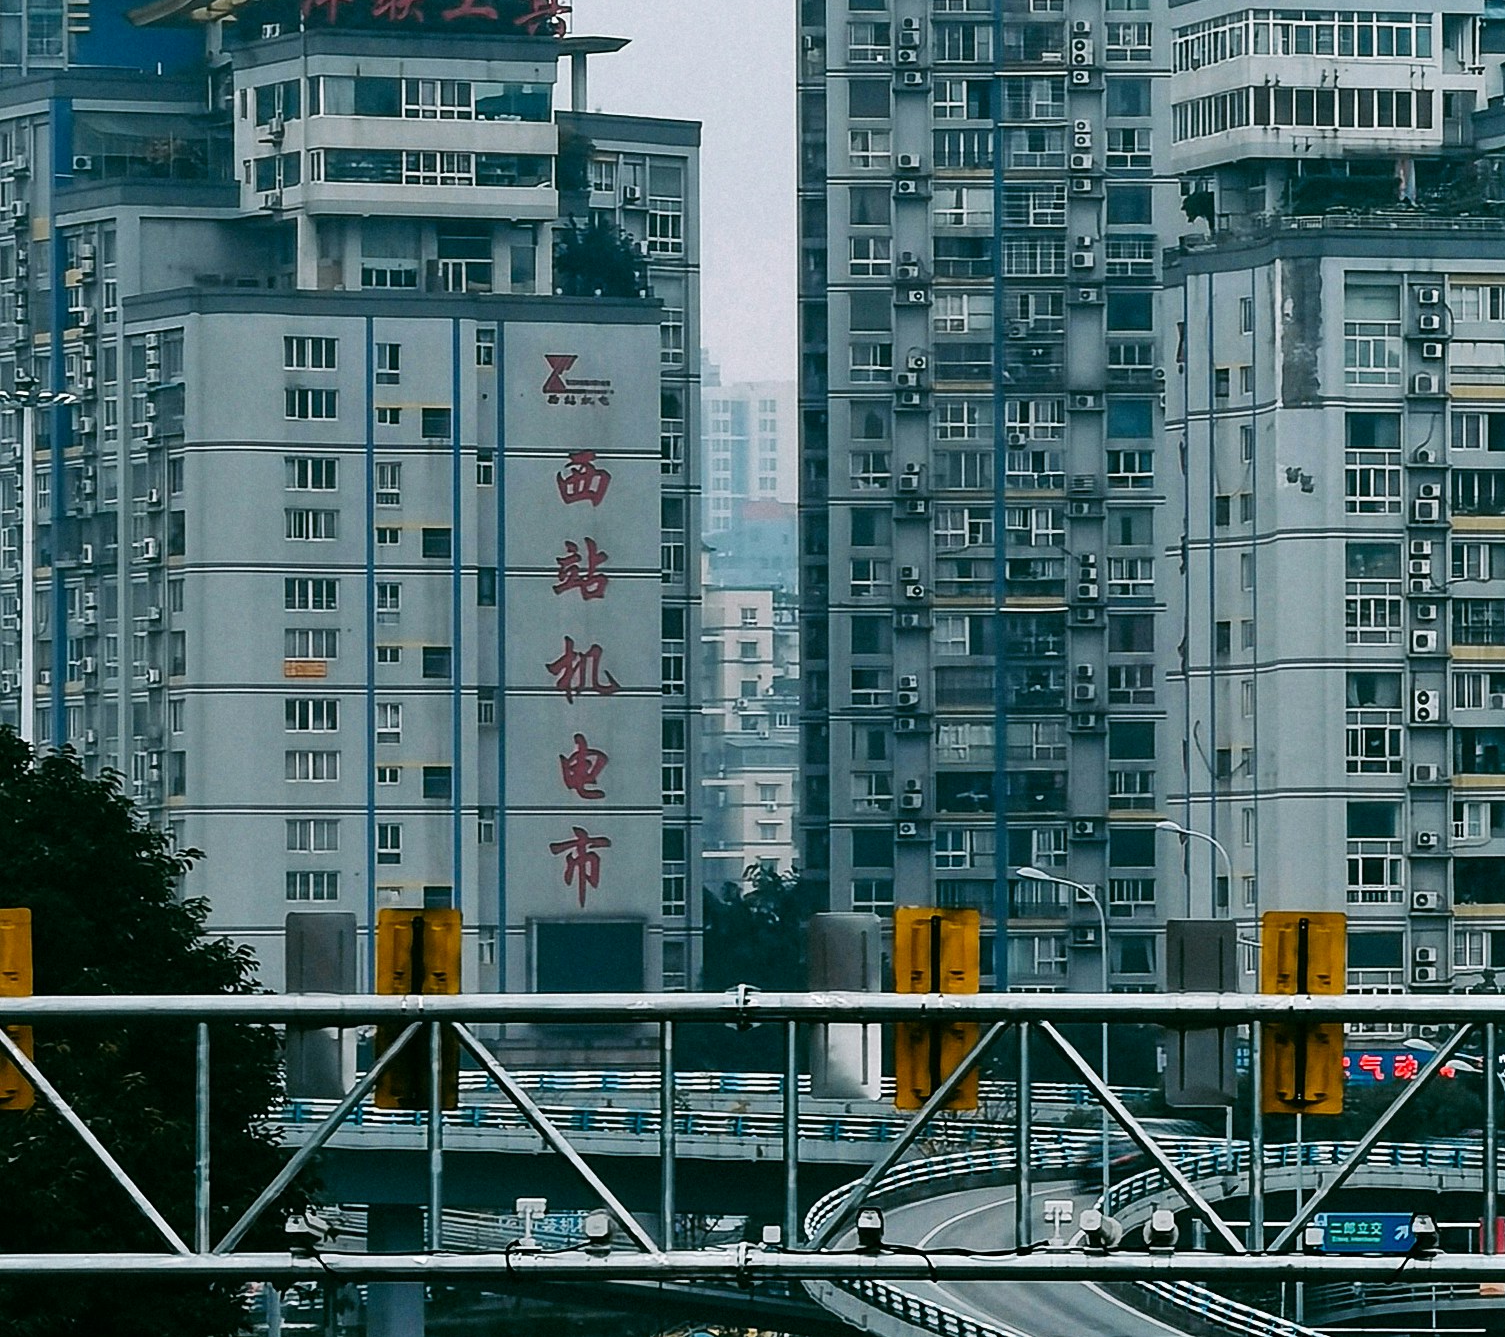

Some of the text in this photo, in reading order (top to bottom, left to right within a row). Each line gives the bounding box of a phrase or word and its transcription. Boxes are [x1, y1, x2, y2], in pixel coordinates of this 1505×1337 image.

[545, 450, 619, 909] 西站机电市
[1330, 1221, 1383, 1235] 二郎立交
